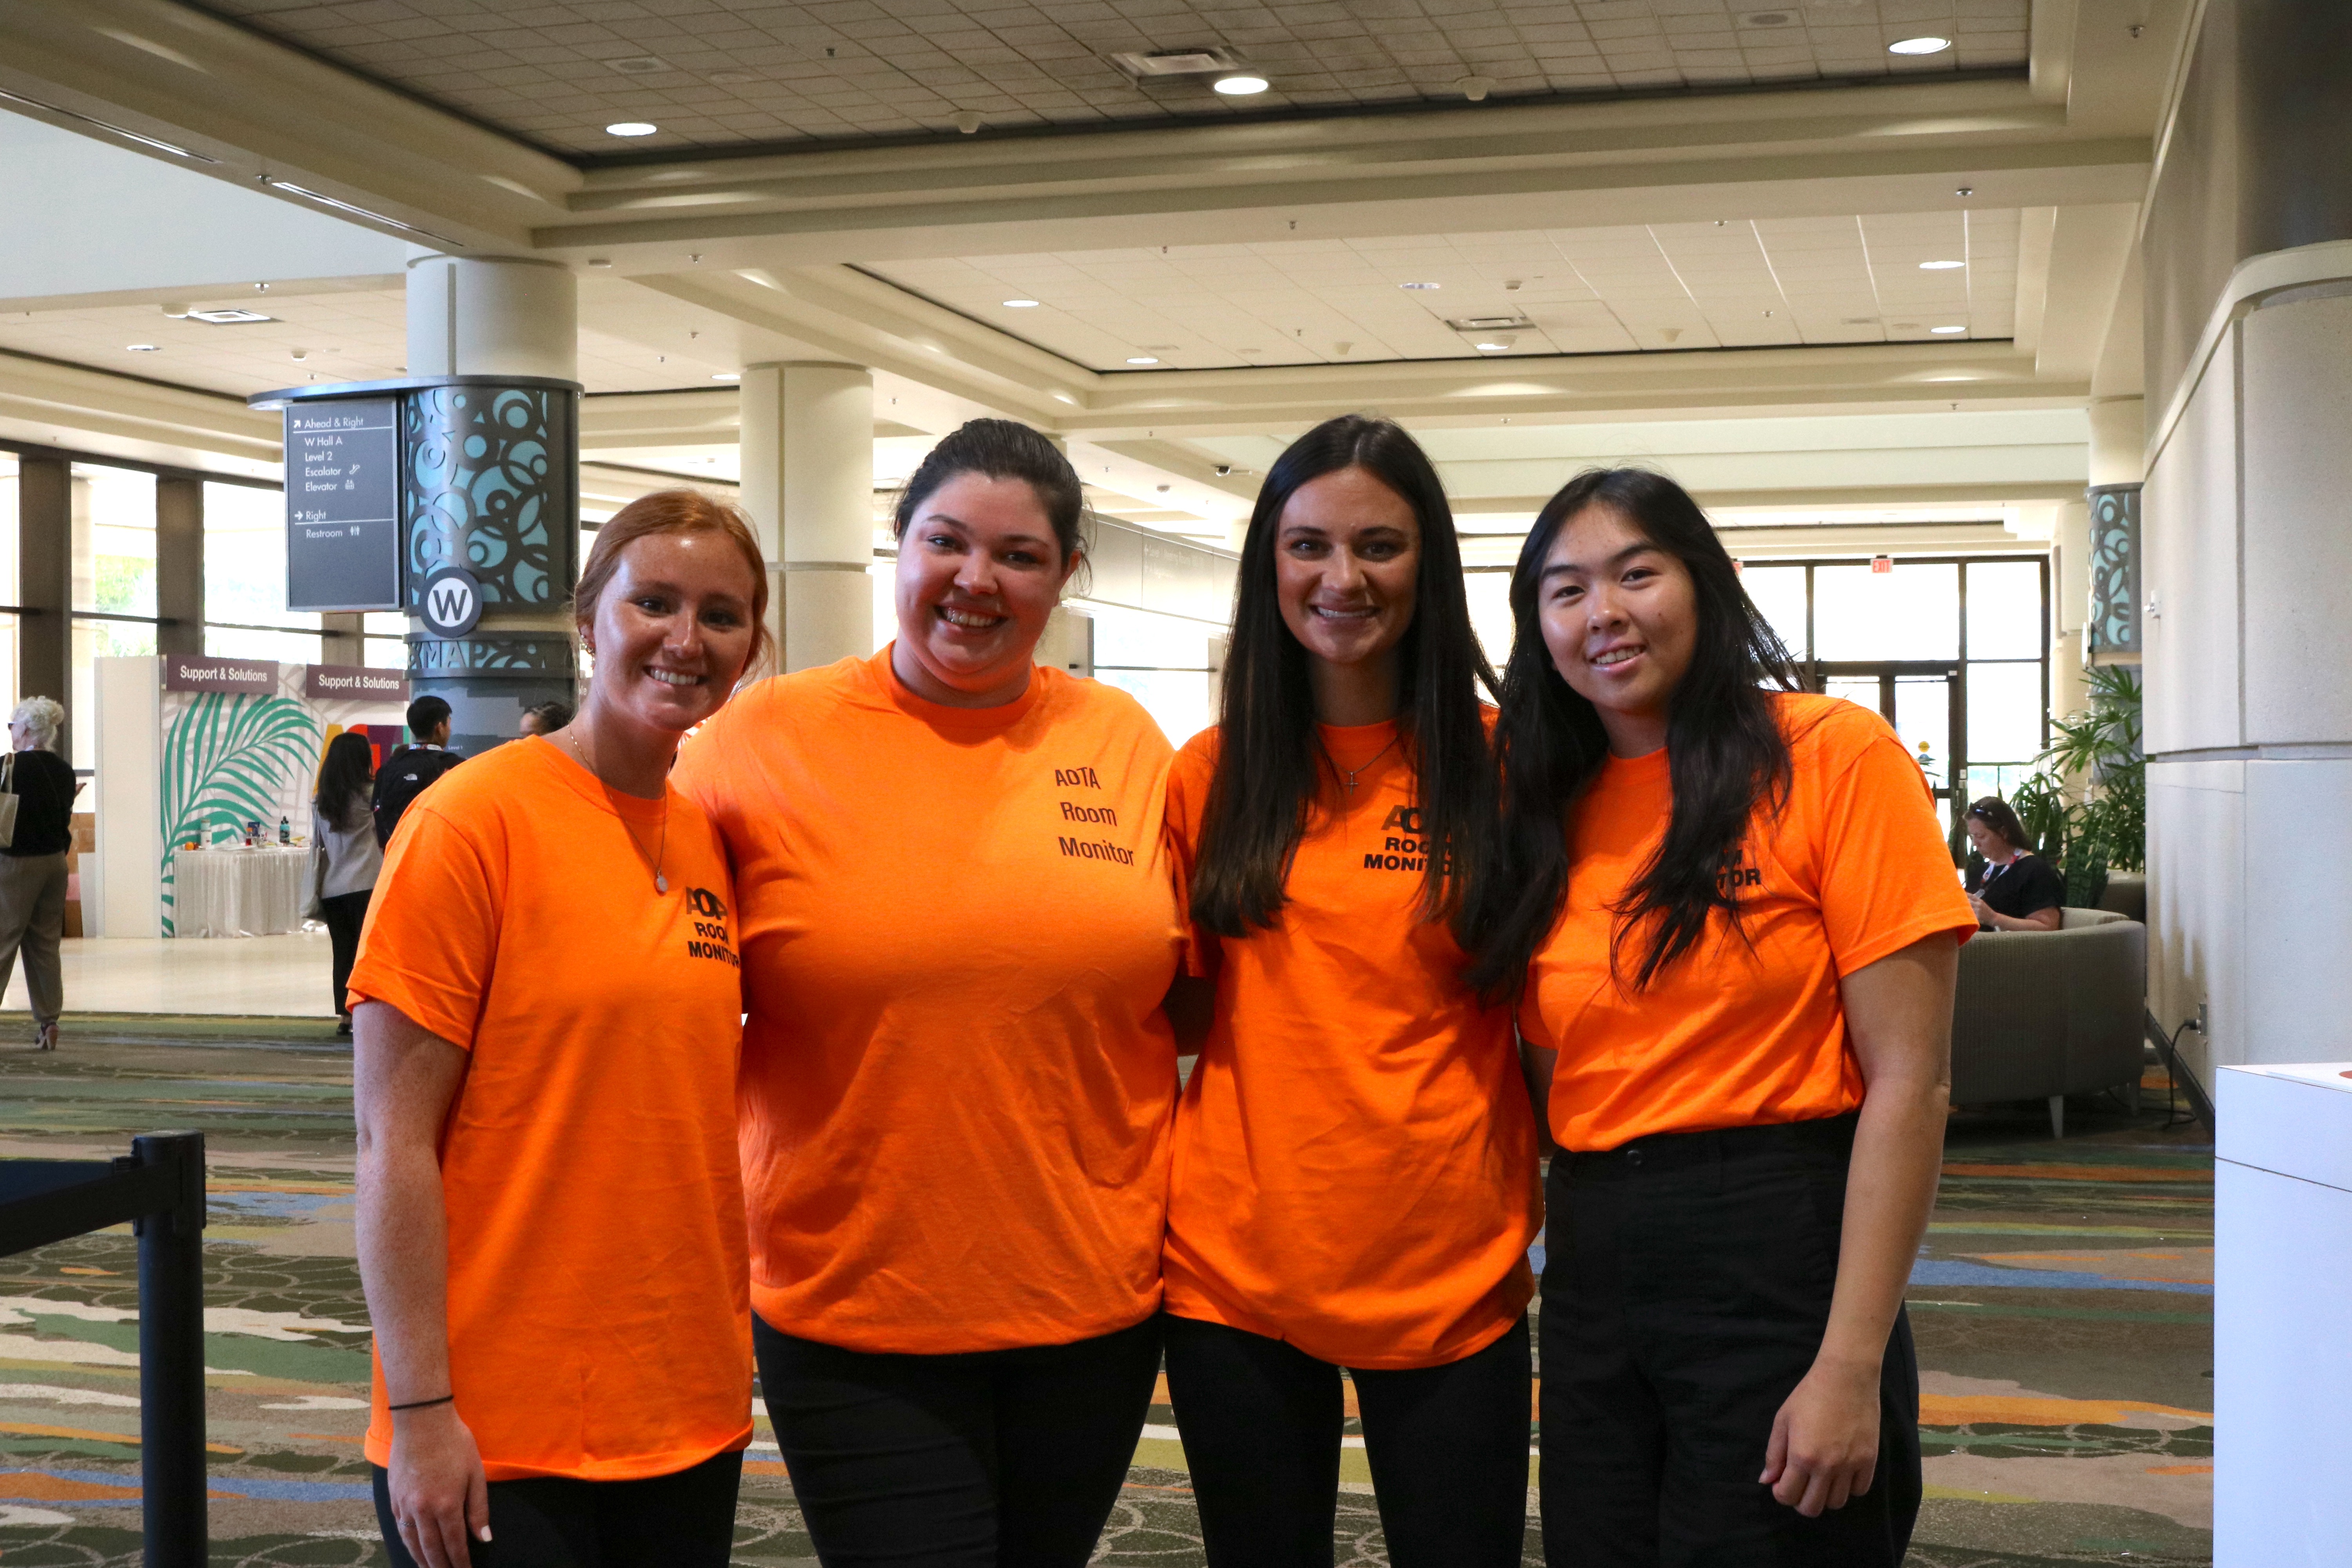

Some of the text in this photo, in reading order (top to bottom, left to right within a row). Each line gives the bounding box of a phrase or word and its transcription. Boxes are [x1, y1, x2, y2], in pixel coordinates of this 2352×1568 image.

[305, 416, 363, 429] Ahead & Right
[305, 436, 343, 446] W Hall A
[305, 452, 332, 462] Level 2
[305, 466, 341, 477] Escalator
[306, 482, 337, 492] Elevator
[306, 510, 326, 523] Right
[306, 529, 343, 538] Restroom
[1873, 560, 1890, 573] EXIT
[433, 589, 468, 621] W
[180, 665, 267, 682] Support & Solutions
[319, 673, 399, 690] Support & Solutions
[1055, 767, 1102, 789] AOTA
[1060, 802, 1117, 827] Room
[1058, 837, 1134, 866] Monitor
[1385, 837, 1446, 855] ROO
